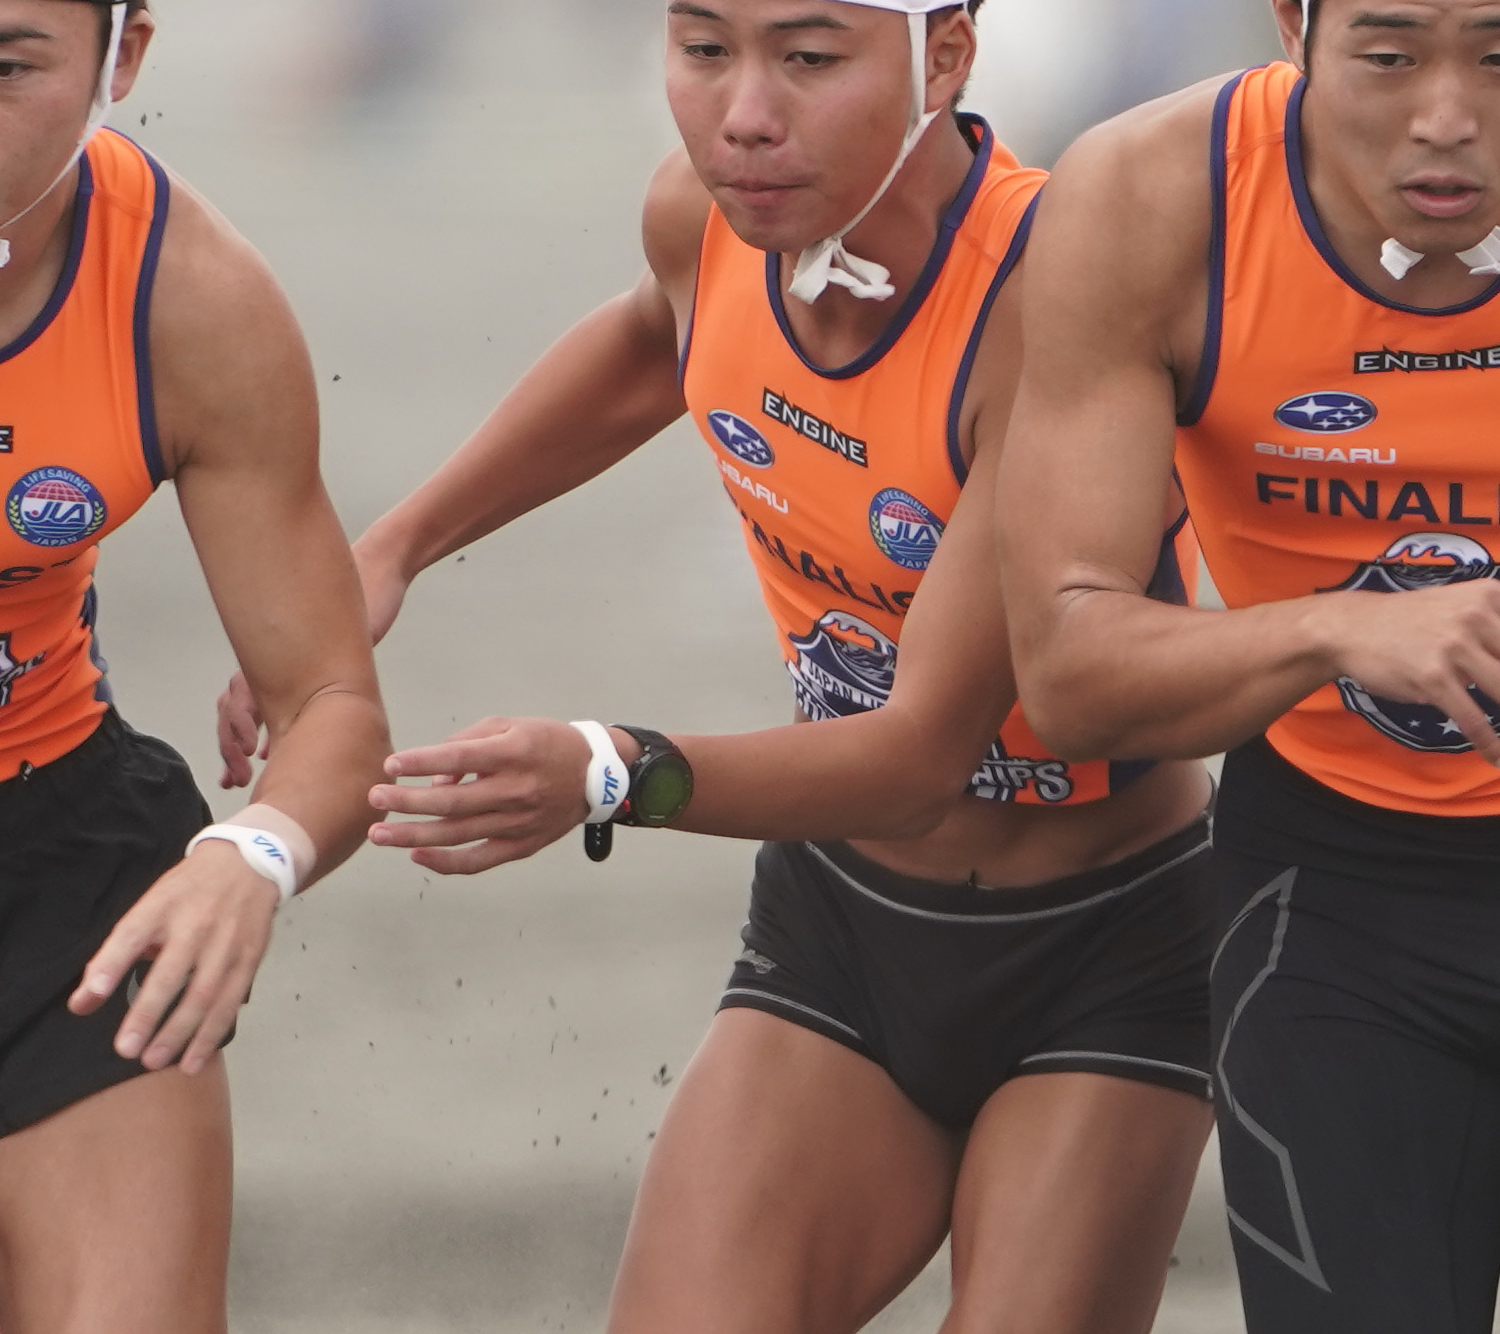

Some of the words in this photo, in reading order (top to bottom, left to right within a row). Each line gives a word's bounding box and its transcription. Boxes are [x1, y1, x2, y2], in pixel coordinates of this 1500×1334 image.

[763, 392, 867, 465] ENGINE
[1254, 441, 1396, 464] SUBARU
[21, 468, 92, 493] LIFESAVING
[722, 460, 788, 514] BARU
[24, 501, 86, 524] JLA
[882, 521, 937, 544] JLA
[808, 661, 853, 701] JAPAN
